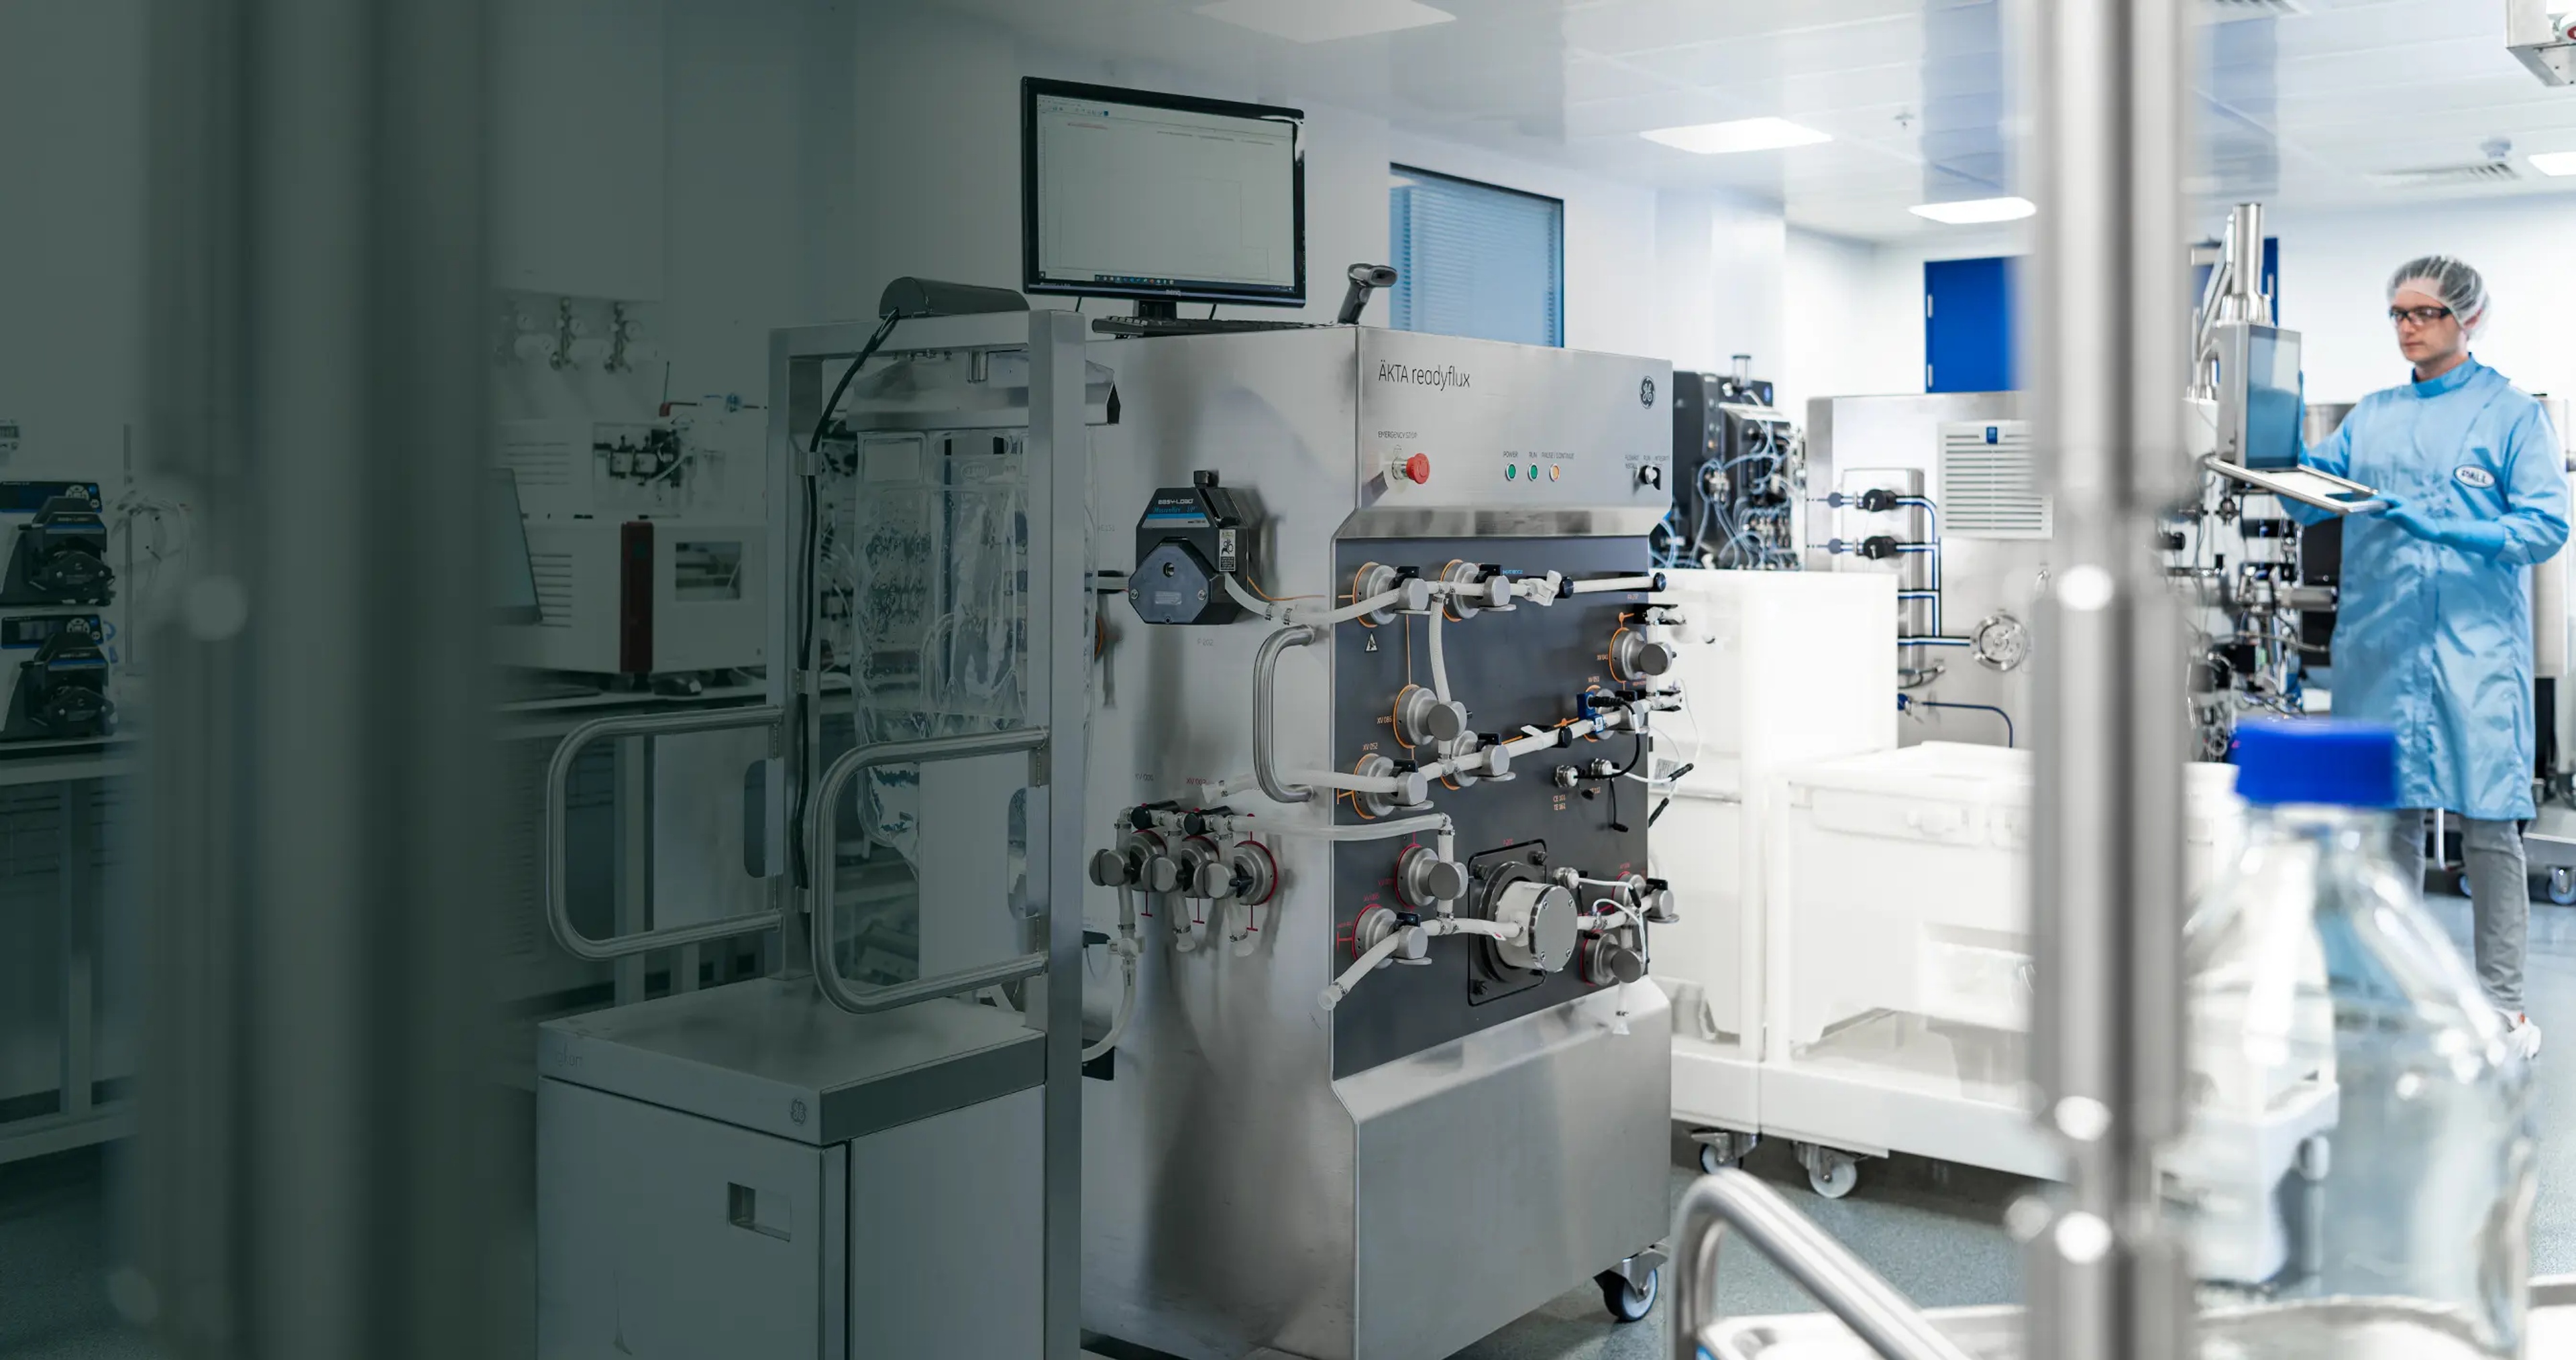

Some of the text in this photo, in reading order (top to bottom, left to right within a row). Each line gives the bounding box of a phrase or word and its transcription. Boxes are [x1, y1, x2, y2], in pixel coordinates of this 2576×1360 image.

[1379, 359, 1470, 391] ÄKTA readyflux
[1377, 716, 1383, 724] XV
